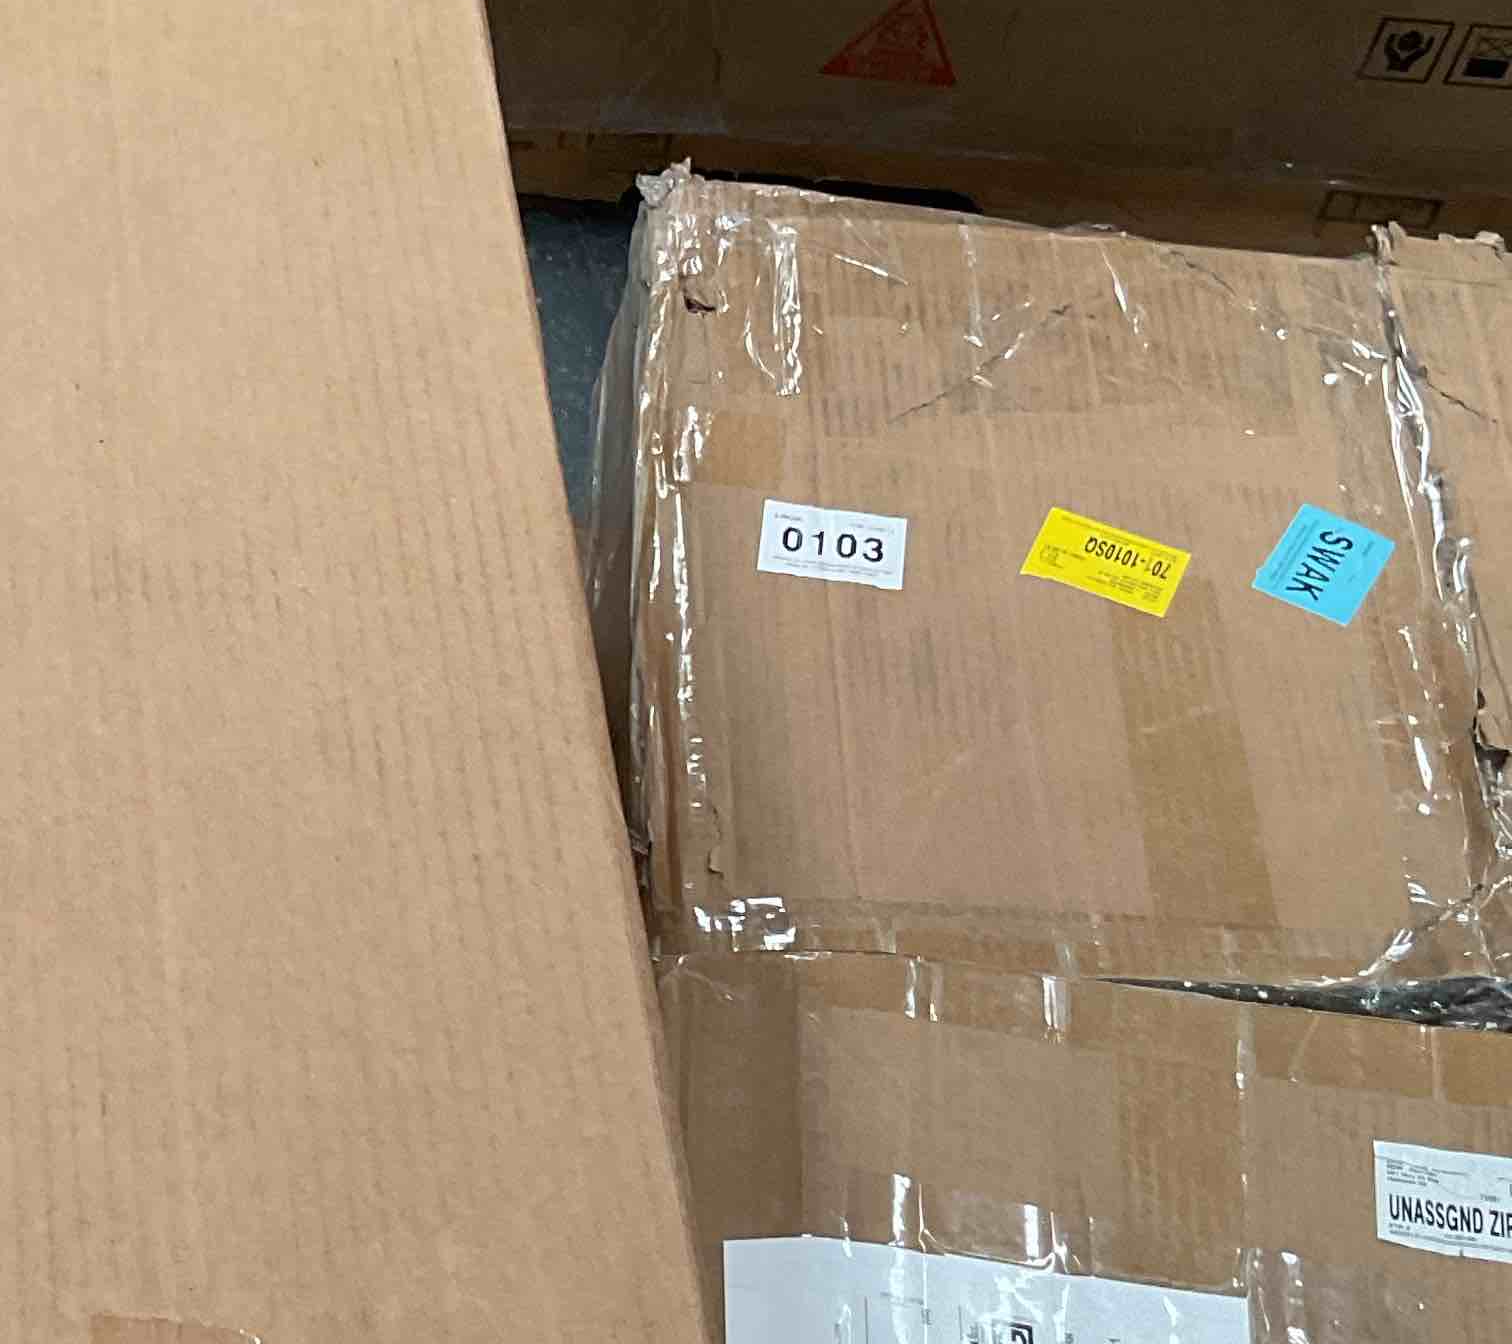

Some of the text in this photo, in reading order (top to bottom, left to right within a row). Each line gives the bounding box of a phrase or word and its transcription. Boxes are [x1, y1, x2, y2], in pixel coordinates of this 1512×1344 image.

[782, 526, 884, 563] 0103
[1287, 528, 1354, 602] SWAK
[1389, 1193, 1484, 1234] UNASSGND
